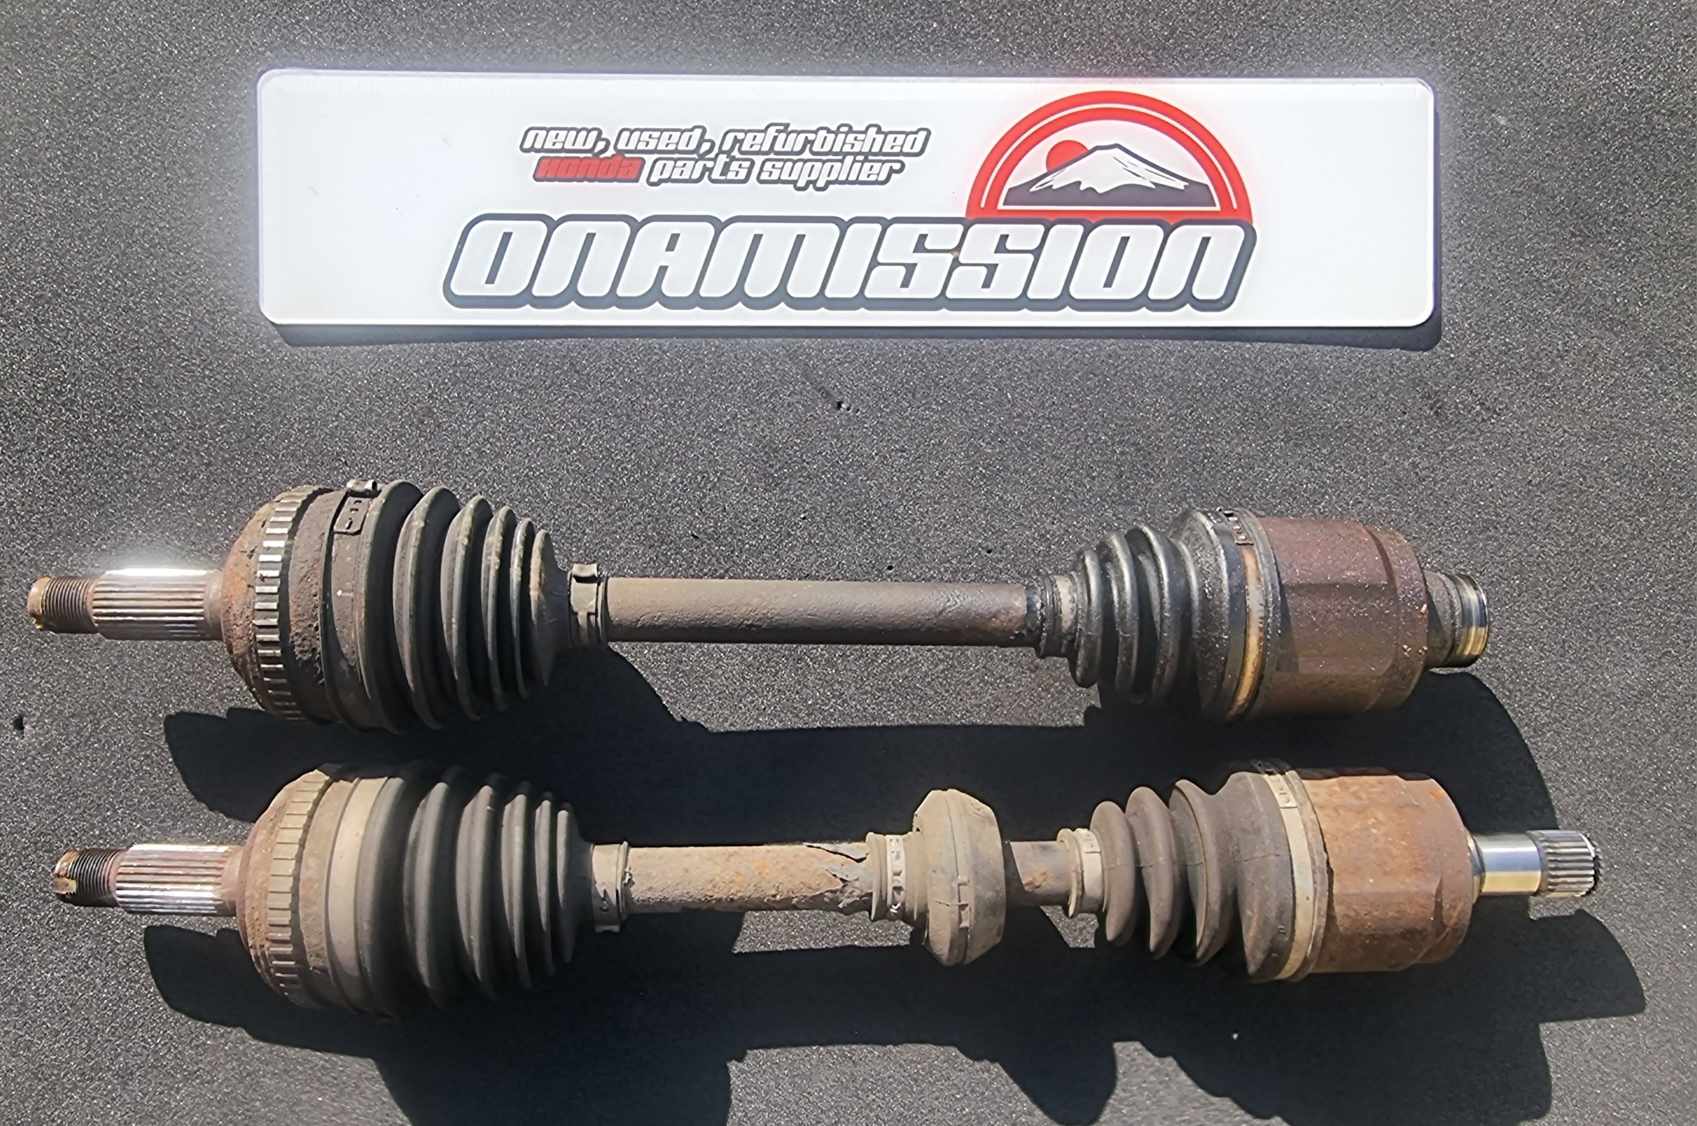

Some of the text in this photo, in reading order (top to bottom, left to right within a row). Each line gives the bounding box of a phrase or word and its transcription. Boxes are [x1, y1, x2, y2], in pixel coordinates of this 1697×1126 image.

[521, 123, 931, 156] new, used, refurbished
[647, 153, 754, 186] parts
[757, 156, 905, 191] supplier
[444, 214, 1257, 311] ONAMISSION
